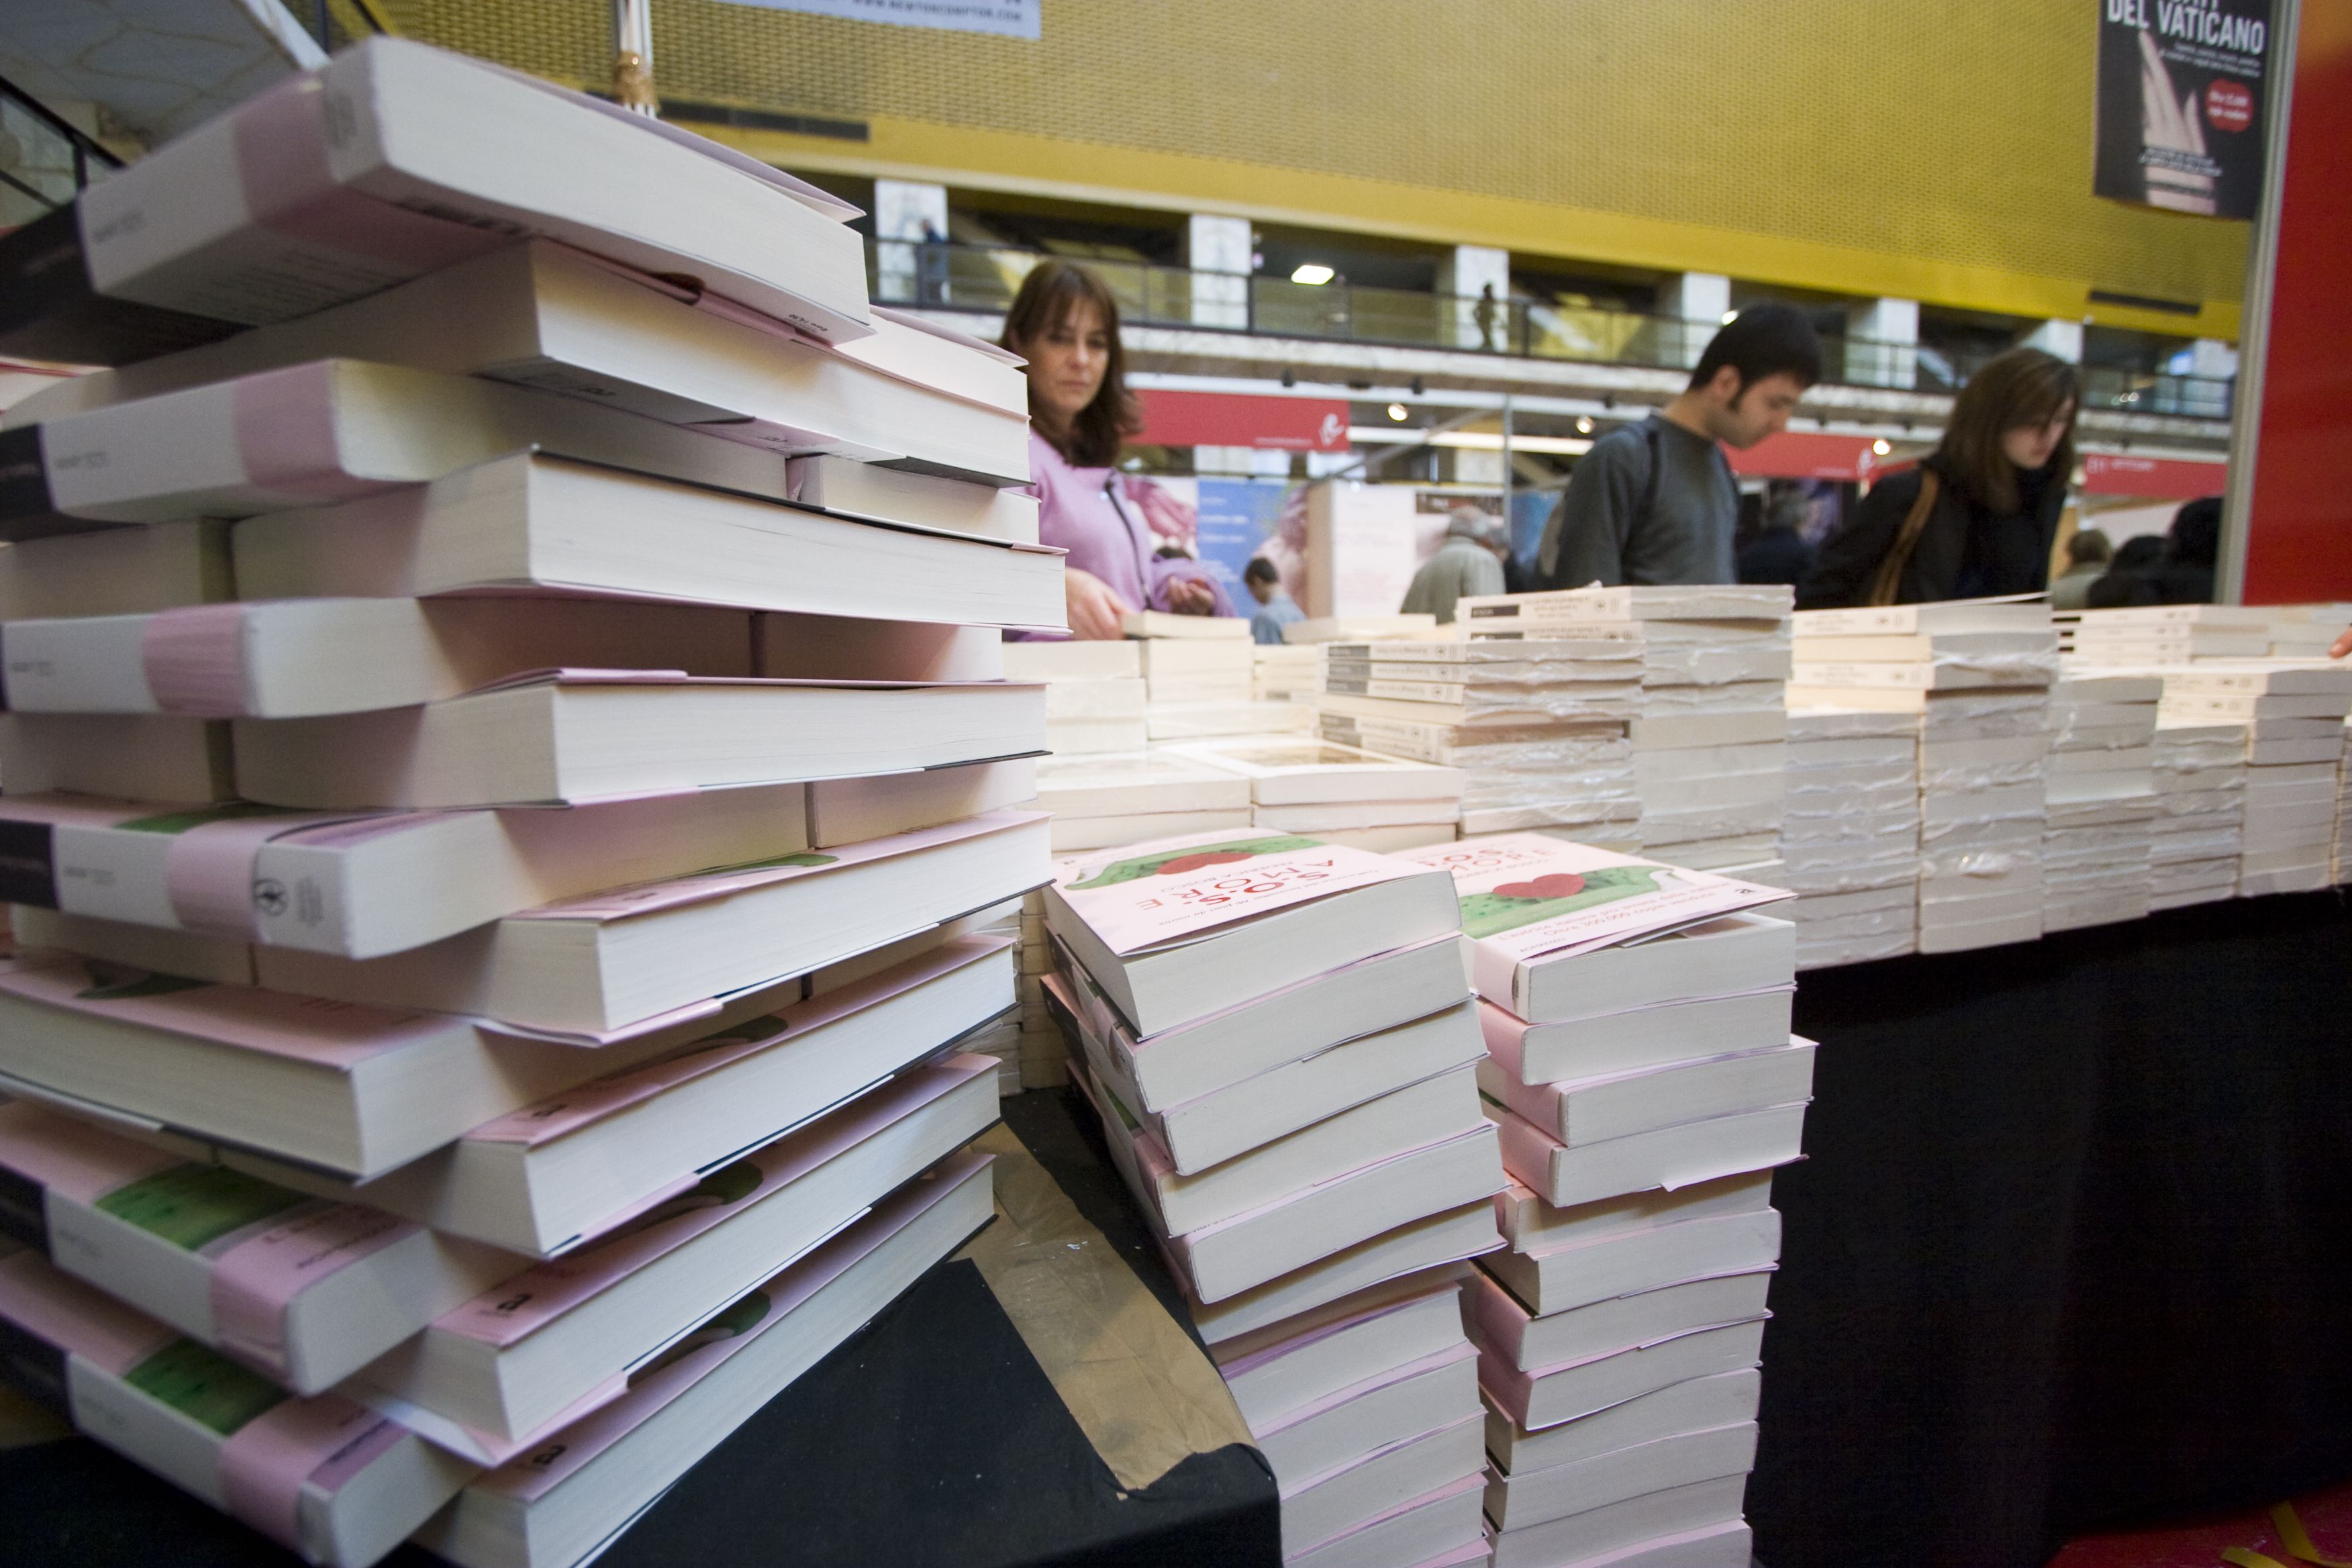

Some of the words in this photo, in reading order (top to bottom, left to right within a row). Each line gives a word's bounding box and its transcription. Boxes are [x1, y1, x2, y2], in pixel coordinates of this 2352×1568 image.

[2107, 0, 2150, 29] DEL
[2158, 0, 2266, 55] VATICANO
[810, 322, 828, 332] Euro
[1222, 861, 1293, 879] FEDERICA
[1134, 859, 1334, 911] AMORE
[1160, 875, 1218, 893] BOSCO
[1183, 871, 1330, 906] S.O.S.
[1207, 902, 1234, 914] piaci
[1236, 899, 1249, 908] Mi
[1158, 914, 1191, 926] morire
[1193, 910, 1206, 918] da
[1543, 926, 1579, 936] Oltre
[1633, 904, 1666, 915] copie
[1672, 892, 1716, 905] vendute
[1519, 937, 1566, 952] ROMANZO
